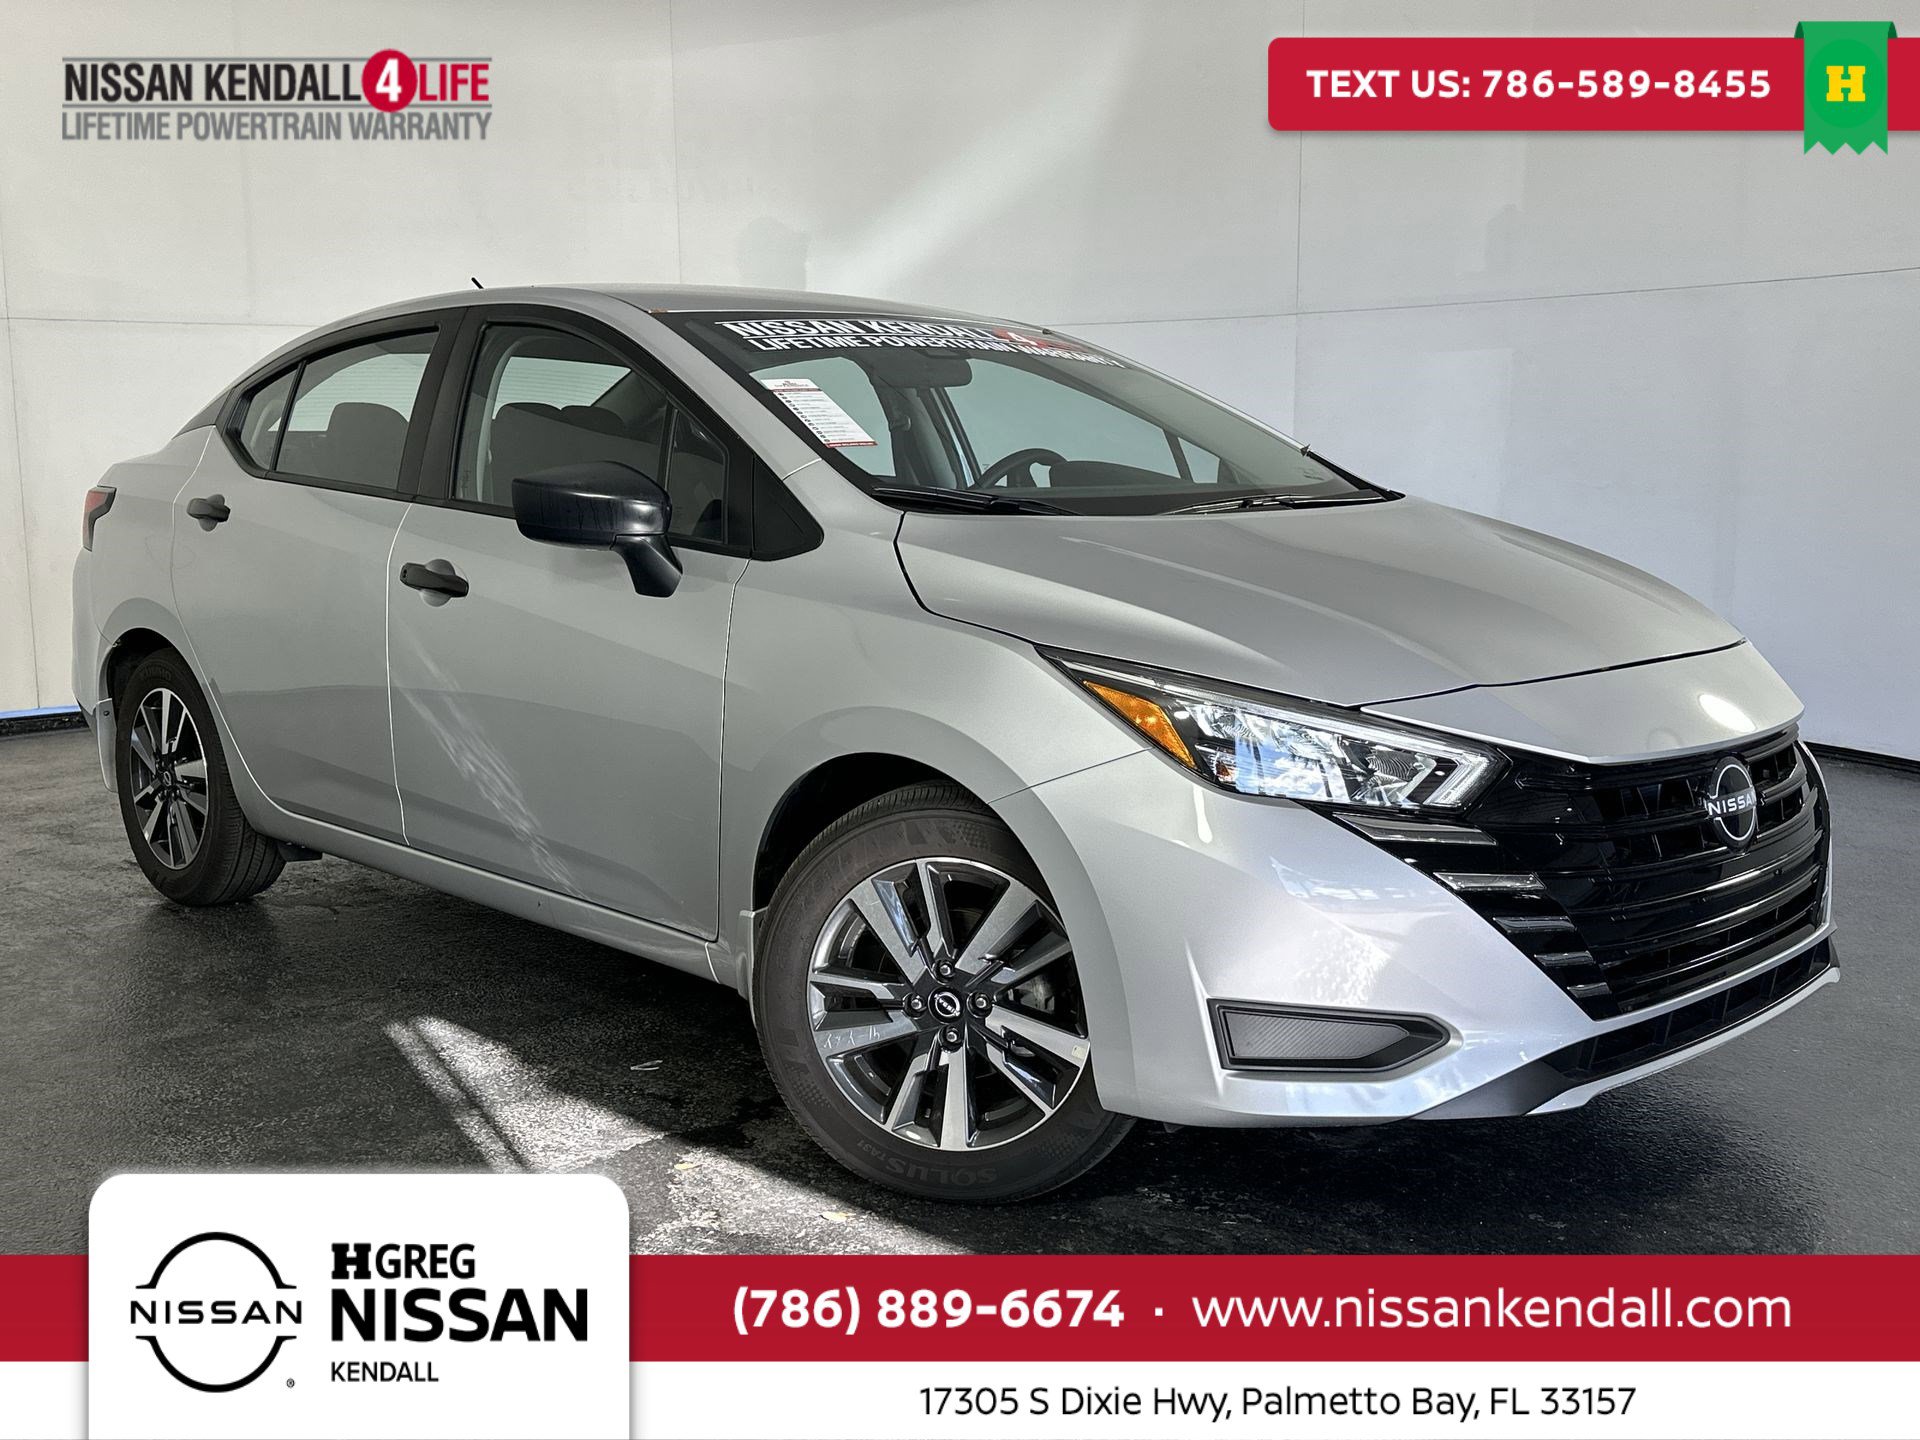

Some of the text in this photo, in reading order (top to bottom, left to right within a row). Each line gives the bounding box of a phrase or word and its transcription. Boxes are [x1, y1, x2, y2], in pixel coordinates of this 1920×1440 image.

[722, 320, 866, 337] NISSAN
[858, 320, 1009, 342] KENDALL
[750, 336, 870, 351] LIFETIME
[862, 336, 1019, 353] POWERTRAIN
[1707, 788, 1757, 815] NISSAN
[885, 1157, 998, 1186] SOLUS
